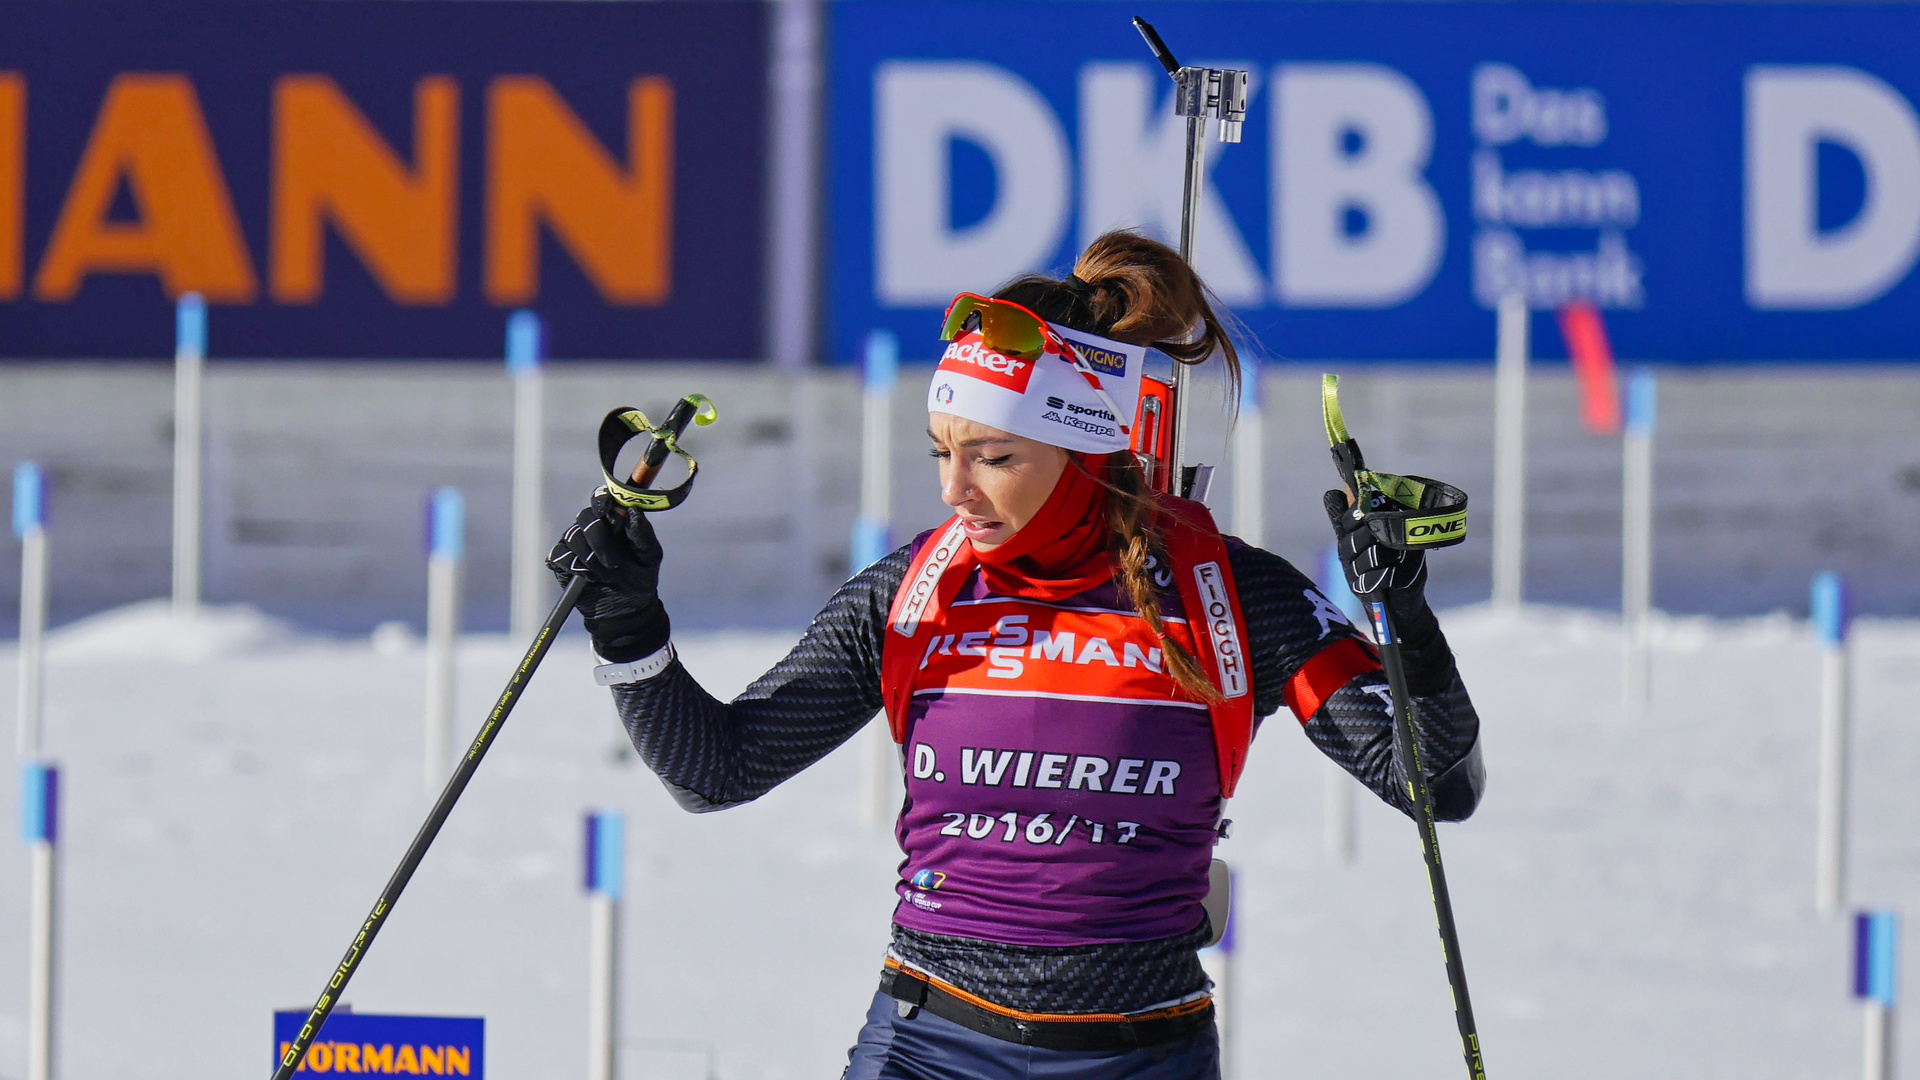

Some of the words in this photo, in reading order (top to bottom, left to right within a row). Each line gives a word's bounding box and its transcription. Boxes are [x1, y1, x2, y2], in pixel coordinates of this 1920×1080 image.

[1471, 63, 1609, 147] Das
[0, 72, 675, 304] ANN
[873, 60, 1448, 309] DKB
[1471, 148, 1640, 229] kann
[1471, 227, 1645, 310] Bank
[939, 341, 1026, 377] acker
[1063, 415, 1115, 437] Kappa
[1066, 403, 1116, 422] sportfu
[1408, 516, 1467, 537] ONE
[1199, 566, 1240, 691] FIOCCHI
[913, 742, 946, 783] D.
[960, 747, 1182, 796] WIERER
[939, 811, 1142, 847] 2016/17
[914, 897, 931, 907] WORLD
[930, 901, 942, 909] CUP
